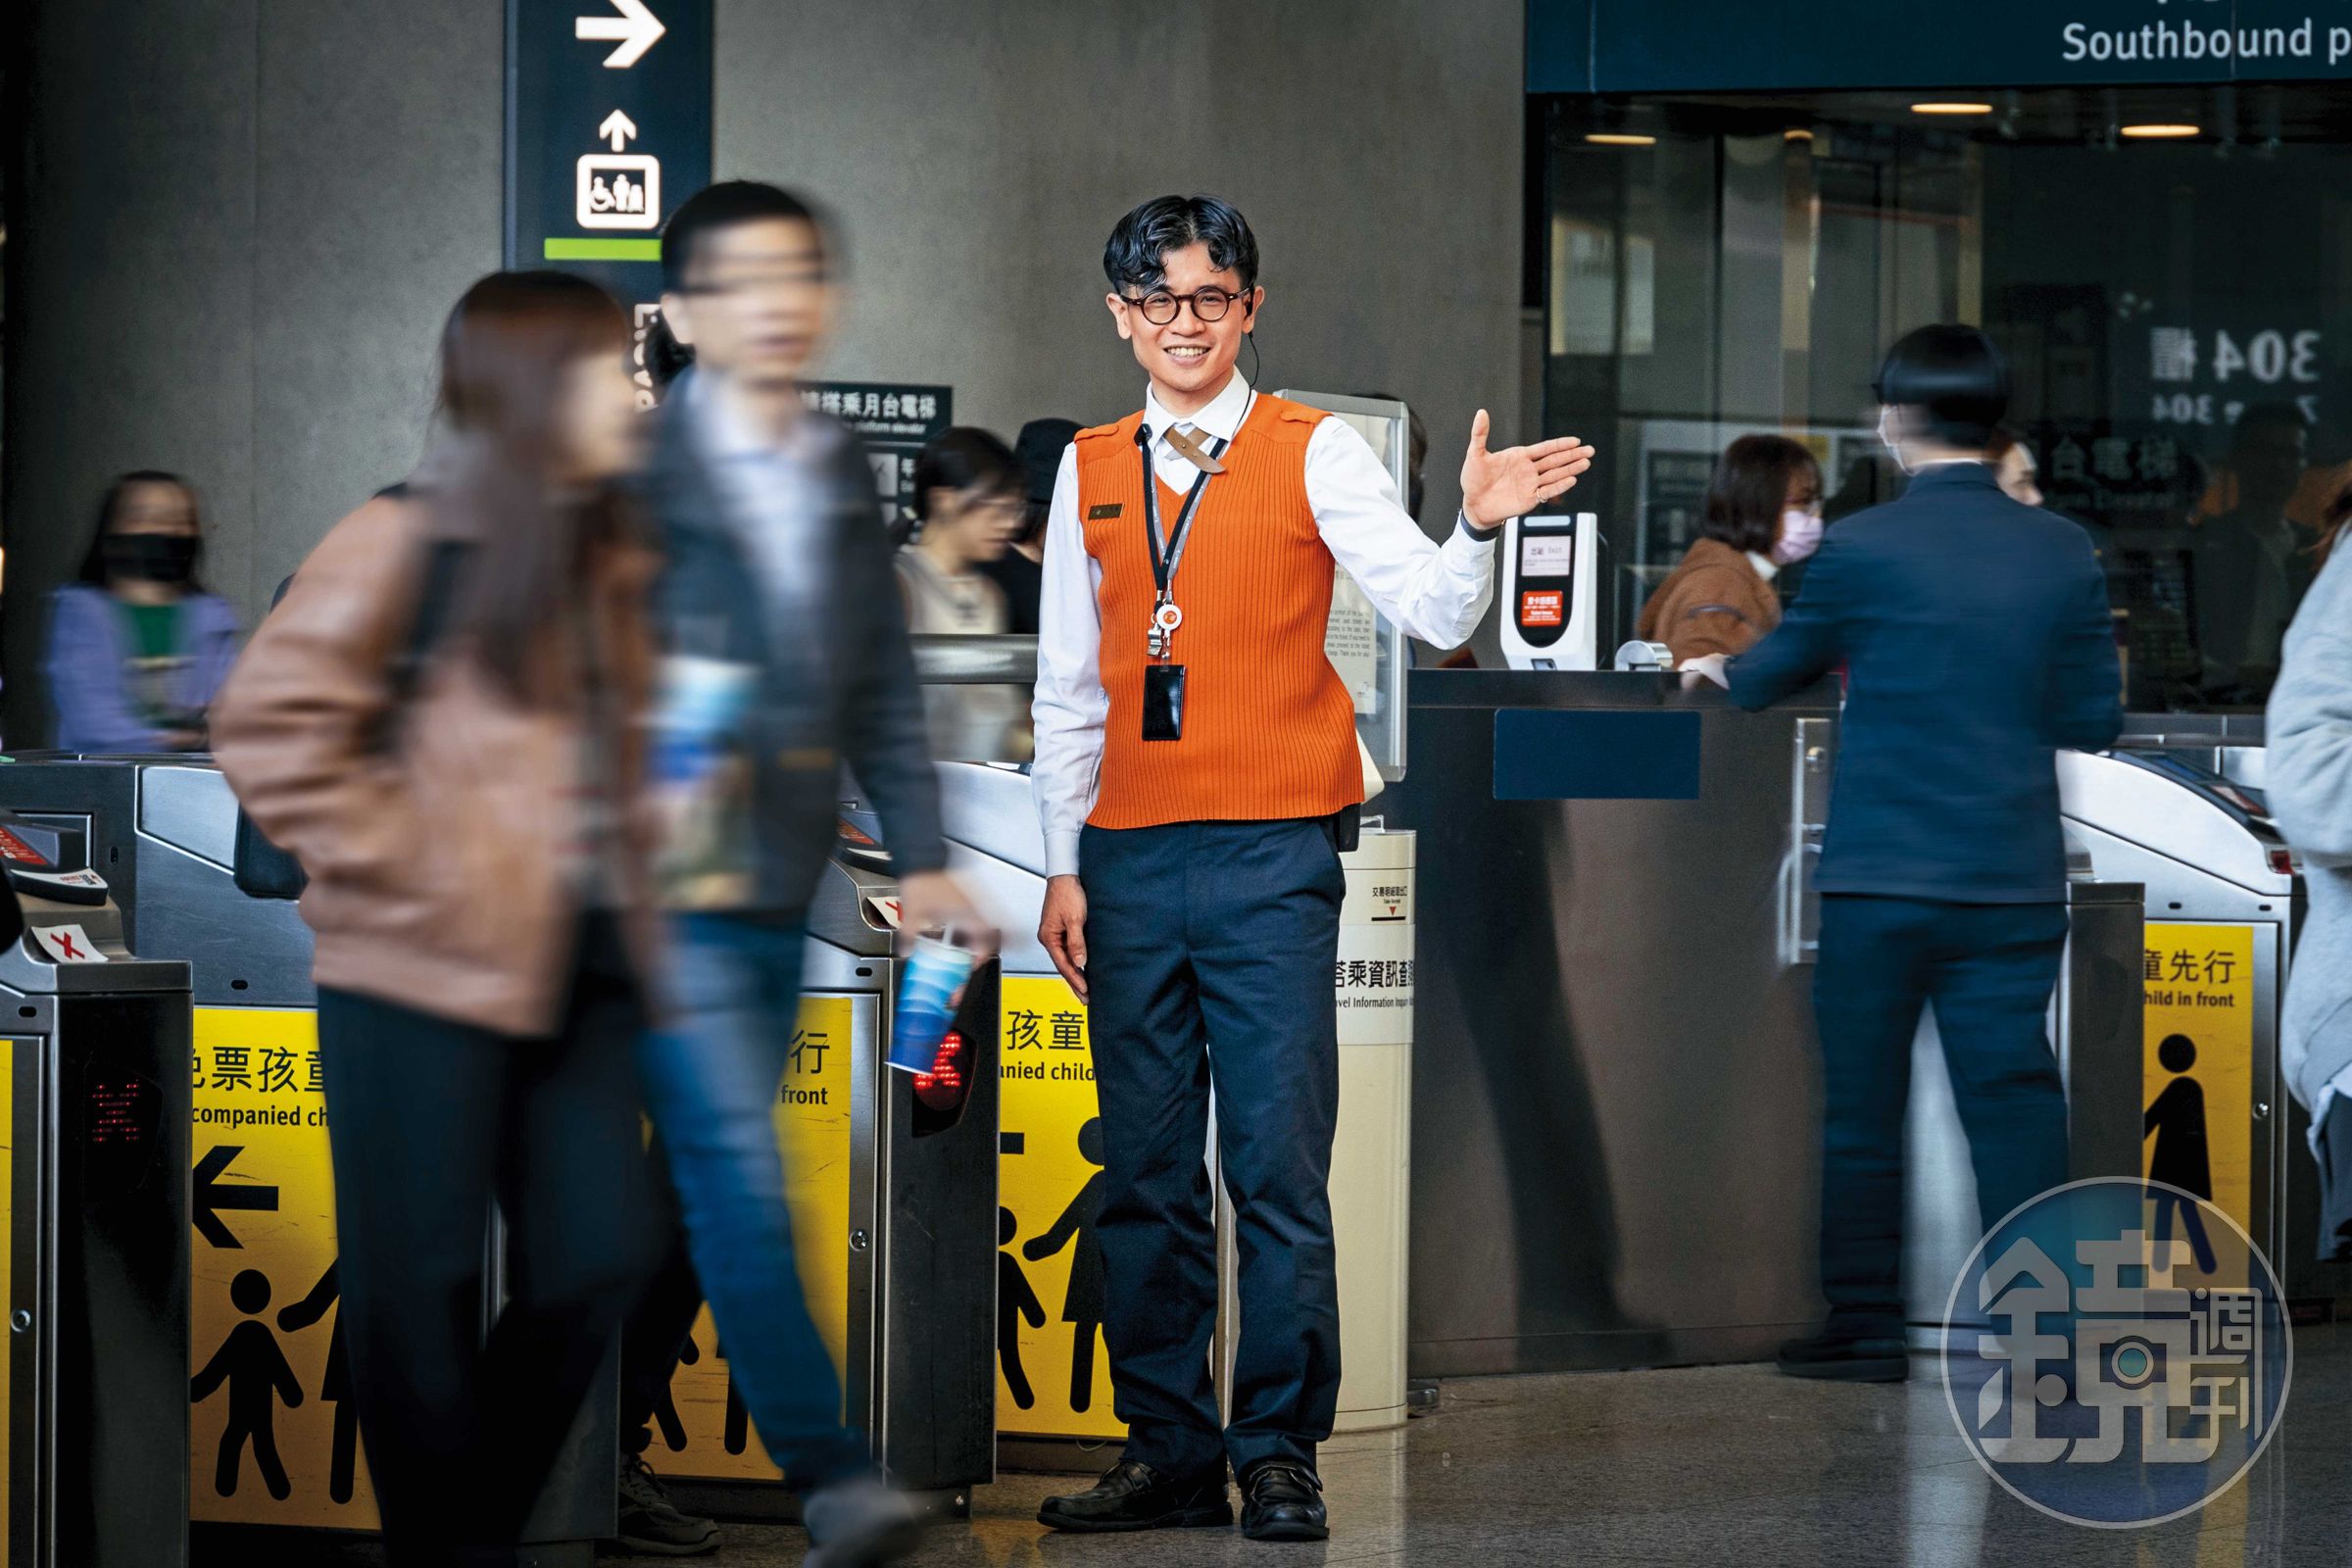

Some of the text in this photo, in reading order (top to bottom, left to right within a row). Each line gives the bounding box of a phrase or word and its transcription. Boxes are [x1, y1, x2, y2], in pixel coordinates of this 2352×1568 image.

[2063, 22, 2312, 61] Southbound
[1353, 997, 1394, 1008] Information
[2178, 992, 2192, 1005] in
[2197, 992, 2234, 1007] front
[1006, 1009, 1085, 1051] 孩童
[790, 1030, 830, 1074] 行
[781, 1085, 828, 1104] front
